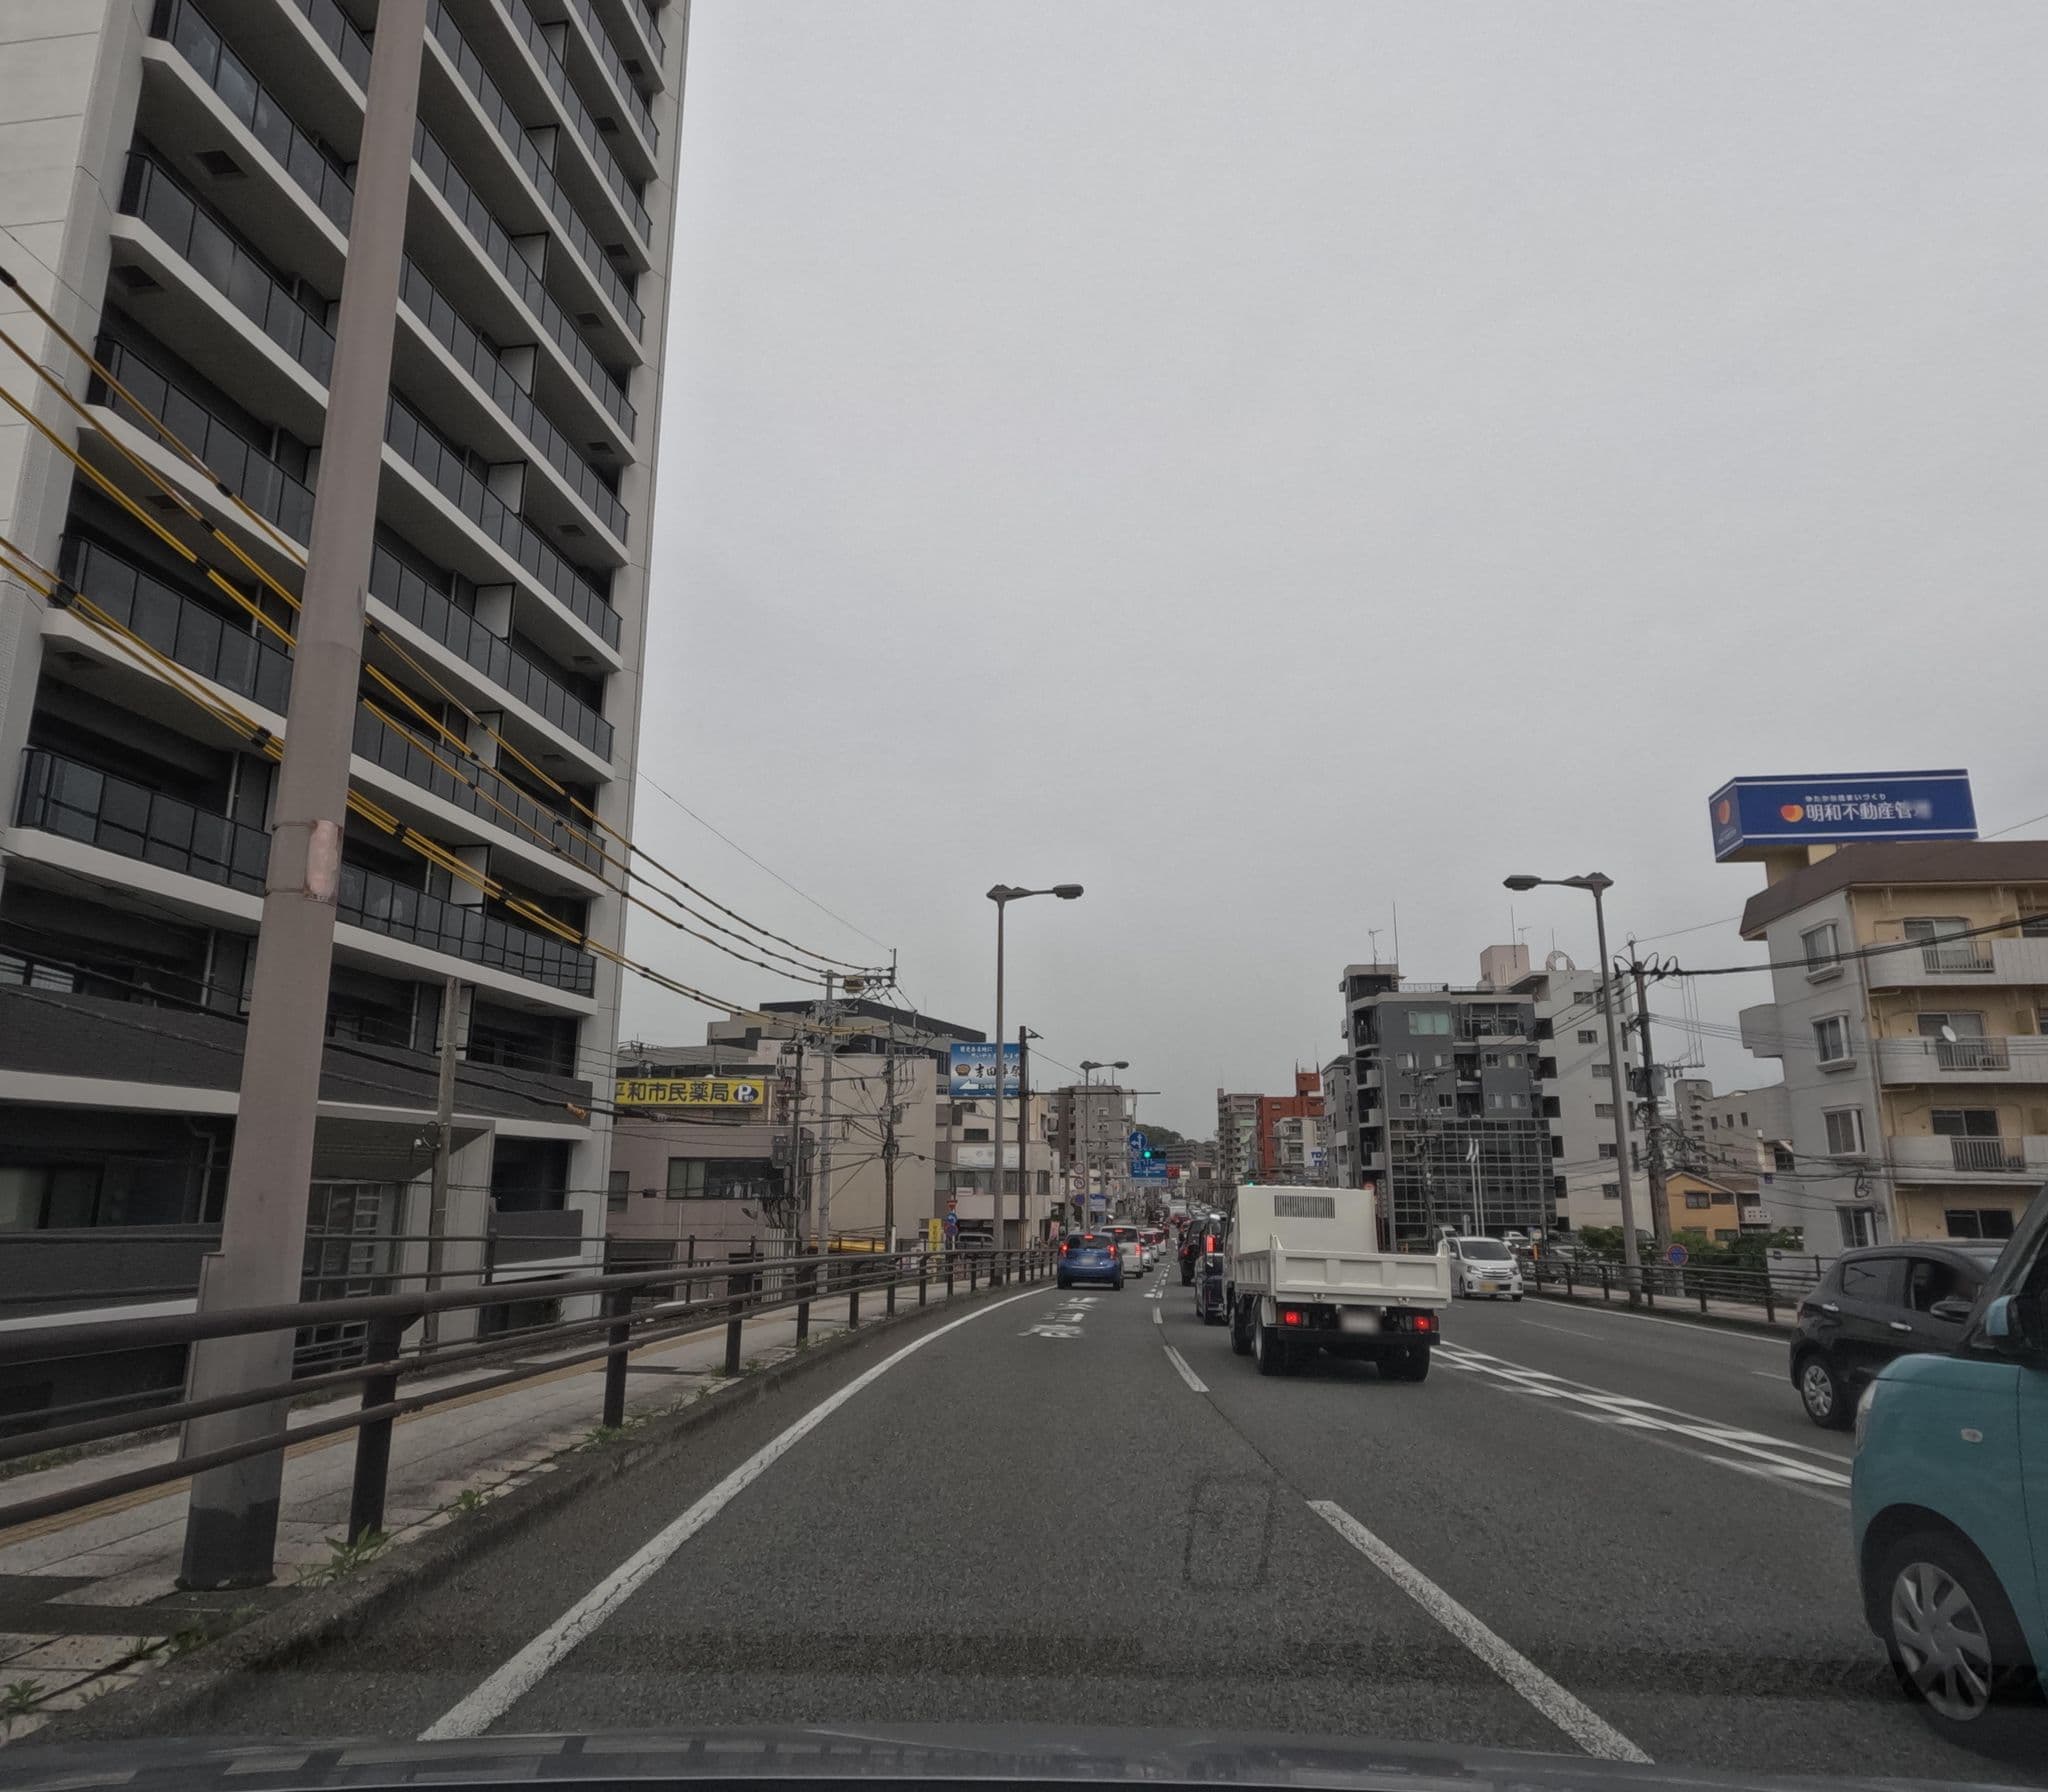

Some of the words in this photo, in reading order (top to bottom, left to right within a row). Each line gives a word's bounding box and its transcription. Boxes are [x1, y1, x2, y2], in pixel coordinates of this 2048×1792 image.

[1806, 801, 1930, 821] 明和不動産管
